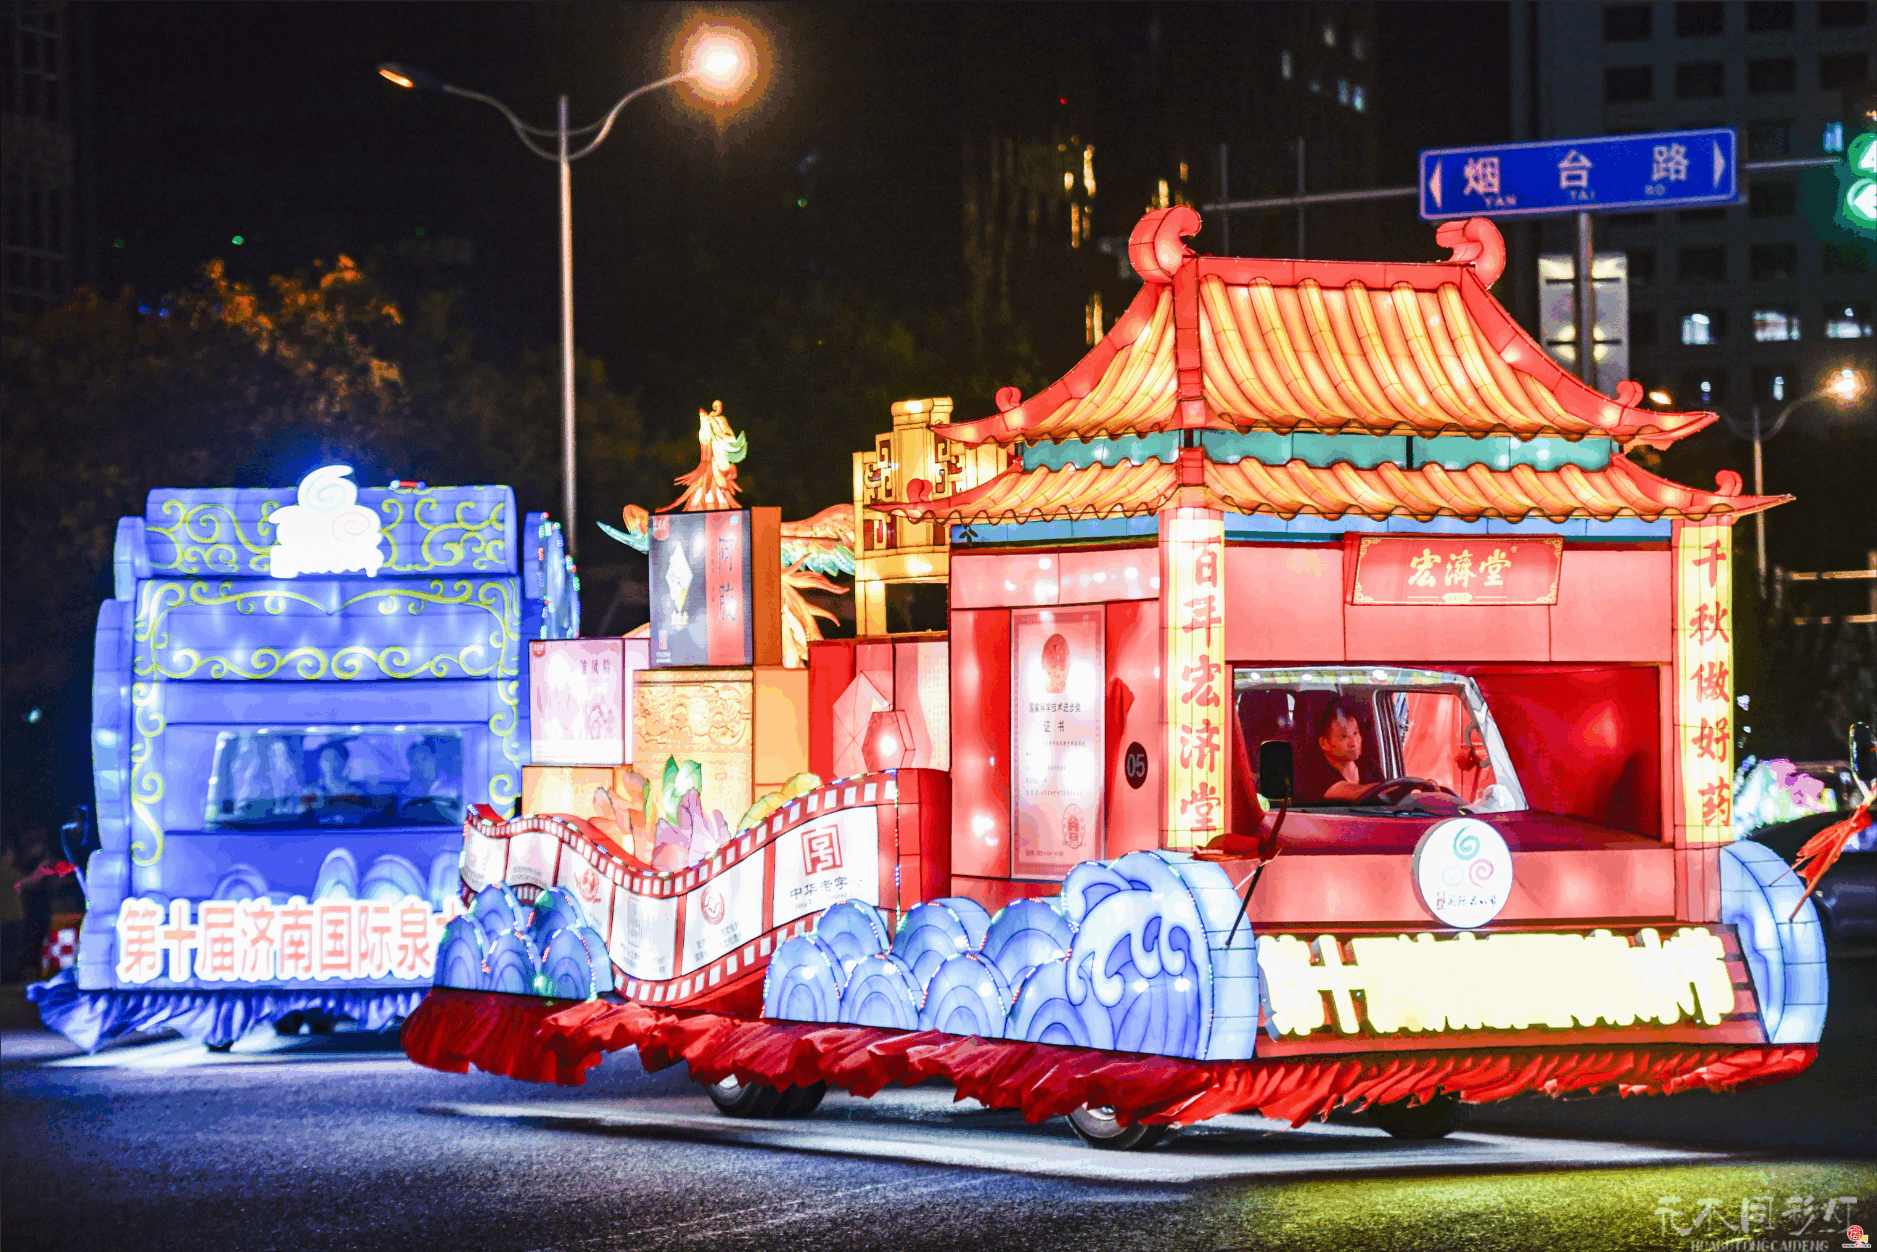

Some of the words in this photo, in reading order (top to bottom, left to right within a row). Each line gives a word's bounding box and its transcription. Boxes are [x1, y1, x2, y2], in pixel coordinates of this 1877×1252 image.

[1463, 142, 1691, 197] 烟台路
[1180, 535, 1222, 832] 百年宏济堂
[1689, 539, 1731, 827] 千秋做好药
[1126, 753, 1146, 778] 05
[789, 875, 863, 901] 中华老字
[119, 898, 458, 980] 第十届济南国际泉
